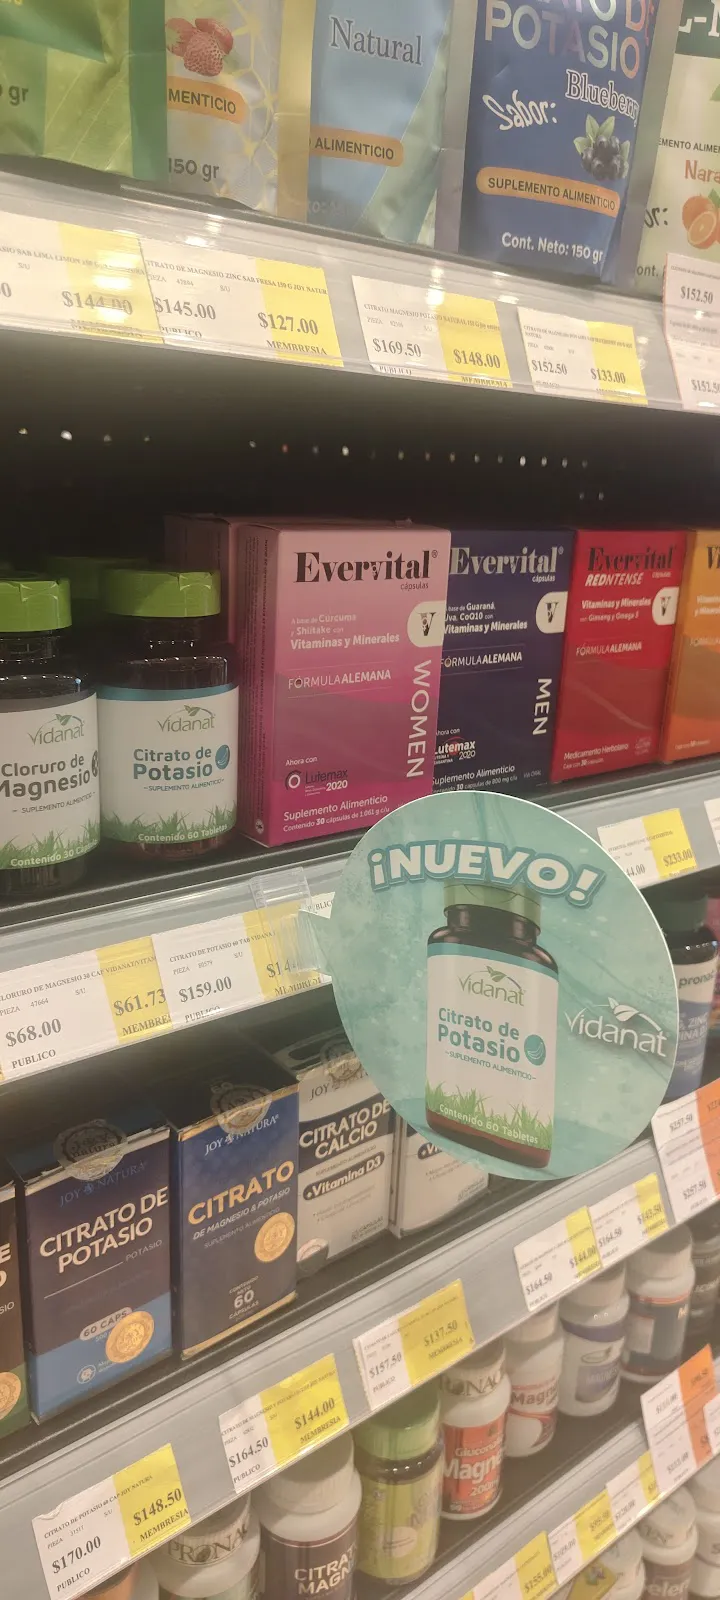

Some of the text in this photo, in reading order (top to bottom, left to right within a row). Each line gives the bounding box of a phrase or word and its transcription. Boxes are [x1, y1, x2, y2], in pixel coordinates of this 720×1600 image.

[329, 16, 423, 66] Natural
[484, 0, 640, 79] POTASIO
[482, 89, 558, 131] Sabor:
[314, 136, 394, 160] ALIMENTICIO
[201, 163, 220, 182] gr
[487, 177, 617, 211] SUPLEMENTO ALIMENTICIO
[501, 231, 604, 265] Cont. Neto: 150 gr
[187, 266, 225, 279] MAGNESIO
[680, 285, 714, 304] $152.50
[154, 297, 319, 336] $145.00 $127.00
[266, 339, 328, 356] MEMBRESIA
[372, 337, 501, 369] $169.50 $148.00
[531, 359, 626, 385] $152.50 $133.00
[293, 549, 431, 584] Evervital
[450, 546, 558, 576] Evervital
[587, 545, 673, 572] Evervital
[400, 581, 429, 592] cápsulas
[531, 574, 556, 584] cápsulas
[459, 611, 484, 621] CoQ10
[581, 599, 615, 610] Vitaminas
[483, 624, 490, 635] y
[490, 620, 528, 632] Minerales
[290, 632, 401, 650] Vitaminas y Minerales
[405, 659, 432, 779] WOMEN
[532, 677, 552, 736] MEN
[27, 721, 86, 746] Vidanat
[157, 713, 216, 733] Vidanat
[1, 752, 85, 778] Cloruro de
[133, 746, 212, 762] Citrato de
[305, 756, 318, 764] con
[458, 750, 476, 761] 2020
[132, 762, 213, 781] Potasio
[304, 768, 348, 785] Lutemax
[475, 764, 516, 779] Alimenticio
[148, 783, 190, 792] SUPLEMENTO
[325, 779, 348, 792] 2020
[21, 801, 65, 814] SUPLEMENTO
[284, 794, 389, 822] Suplemento Alimenticio
[315, 816, 326, 827] 30
[138, 831, 185, 842] Contenido
[186, 831, 200, 841] 60
[10, 849, 75, 868] Contenido 30
[369, 841, 603, 907] ¡NUEVO!
[169, 951, 197, 963] CITRATO
[197, 948, 206, 956] DE
[206, 941, 232, 954] POTASIO
[33, 984, 44, 994] DE
[45, 974, 83, 991] MAGNESIO
[178, 975, 233, 1003] $159.00
[458, 975, 526, 1007] Vidanat
[5, 987, 167, 1048] $68.00 $61.73
[438, 1008, 520, 1040] Citrato de
[437, 1025, 521, 1063] Potasio
[564, 1011, 671, 1059] Vidanat
[11, 1048, 57, 1070] PUBLICO
[449, 1051, 491, 1068] SUPLEMENTO
[309, 1082, 331, 1101] JOY
[299, 1106, 371, 1148] CITRATO
[439, 1103, 539, 1144] Contenido 60 Tabletas
[204, 1138, 224, 1157] JOY
[314, 1120, 379, 1160] CALCIO
[366, 1155, 382, 1172] D3
[187, 1160, 295, 1226] CITRATO
[39, 1184, 169, 1260] CITRATO DE
[192, 1228, 206, 1241] DE
[206, 1207, 250, 1235] MAGNESIO
[256, 1187, 291, 1208] POTASIO
[57, 1216, 153, 1275] POTASIO
[125, 1239, 163, 1263] POTASIO
[233, 1290, 255, 1309] 60
[83, 1325, 97, 1338] 60
[228, 1396, 336, 1469] $164.50 $144.00
[232, 1415, 342, 1484] PUBLICO MEMBRESIA
[133, 1487, 182, 1526] $148.50
[44, 1503, 103, 1539] CITRATO DE POTASIO
[51, 1535, 102, 1575] $170.00
[56, 1507, 189, 1593] MEMBRESIA PUBLICO
